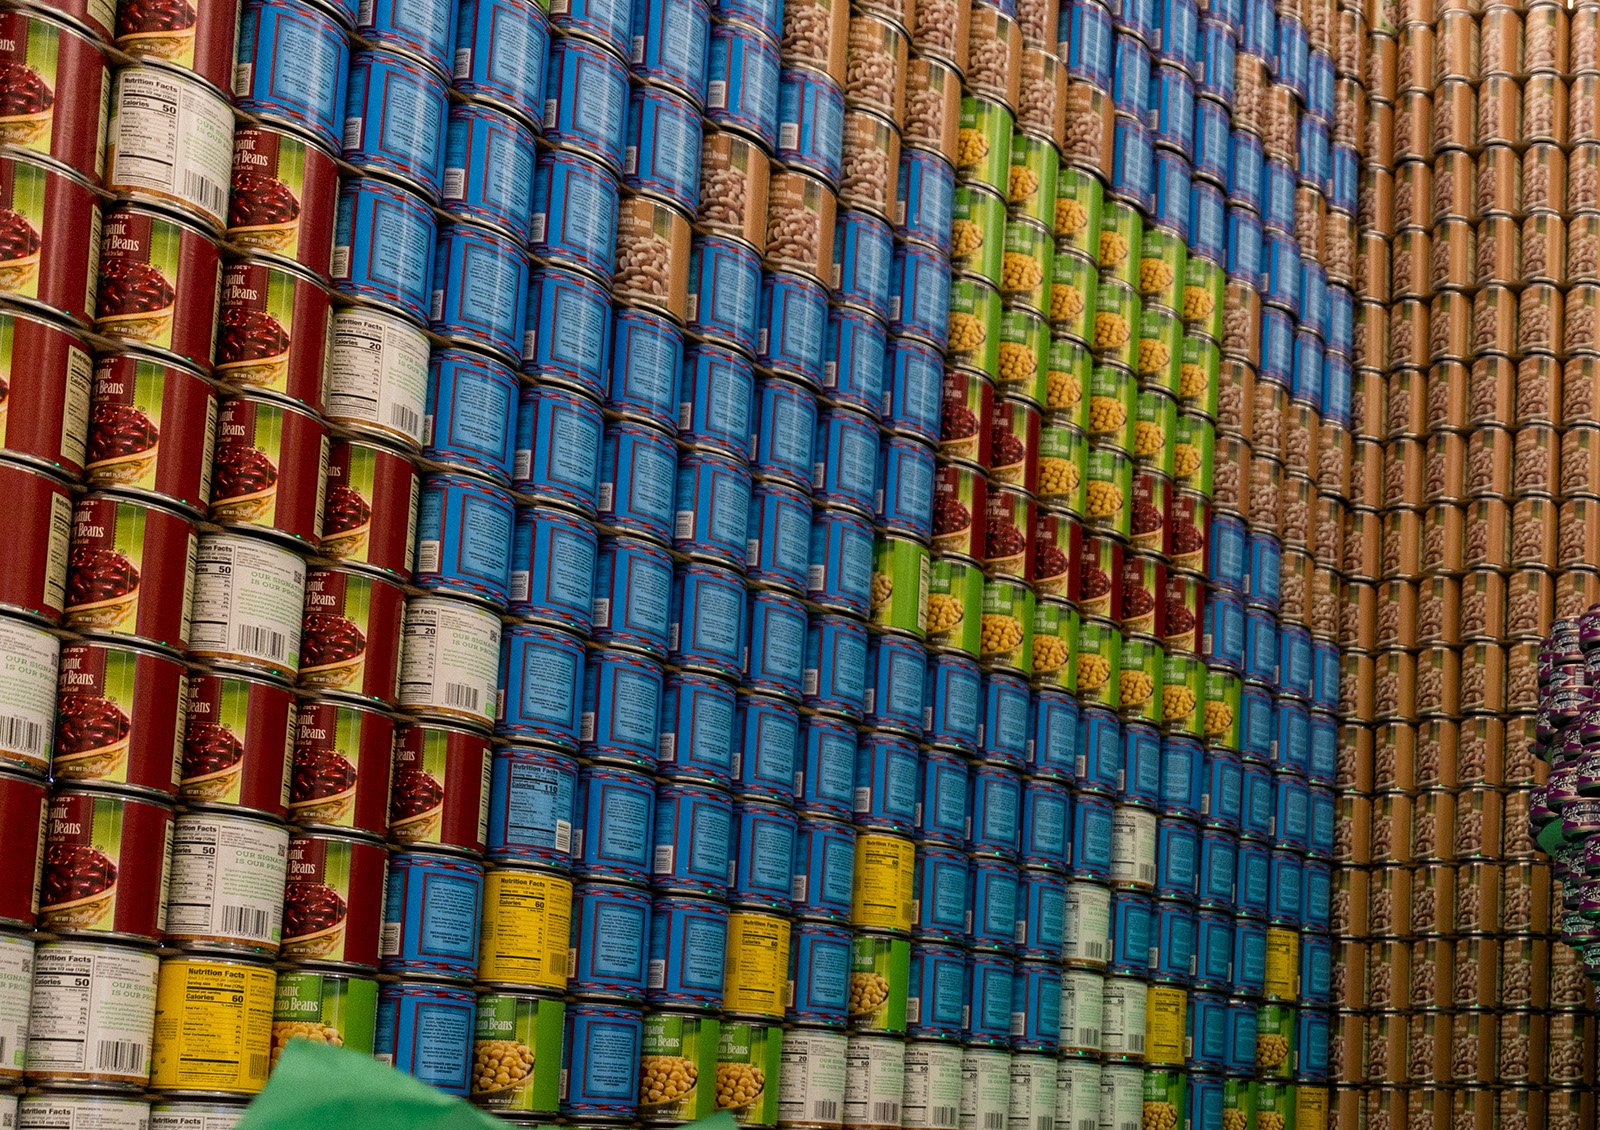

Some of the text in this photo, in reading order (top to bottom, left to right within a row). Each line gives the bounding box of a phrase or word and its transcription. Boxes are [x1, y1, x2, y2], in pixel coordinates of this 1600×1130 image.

[124, 77, 178, 93] Nutrition Facts
[123, 100, 177, 115] Calories 50
[241, 149, 269, 167] Beans
[111, 234, 140, 251] Beans
[231, 285, 258, 300] Beans
[336, 318, 383, 331] Nutrition Facts
[369, 342, 381, 351] 20
[99, 379, 124, 394] Beans
[214, 545, 232, 553] Facts
[219, 566, 231, 574] 50
[311, 591, 336, 606] Beans
[425, 627, 436, 635] 20
[68, 672, 94, 686] Beans
[54, 821, 81, 835] Beans
[198, 825, 217, 833] Facts
[202, 846, 215, 855] 50
[291, 860, 316, 874] Beans
[501, 878, 545, 888] Nutrition Facts
[767, 921, 779, 929] Facts
[68, 955, 91, 963] Facts
[188, 968, 245, 979] Nutrition Facts
[74, 978, 89, 987] 50
[111, 981, 132, 990] OUR
[123, 990, 141, 998] OUR
[186, 993, 244, 1003] Calories 60
[290, 997, 318, 1012] Beans
[489, 1018, 513, 1031] Beans
[657, 1036, 679, 1048] Beans
[725, 1042, 748, 1054] Beans
[21, 1108, 47, 1116] Nutrition
[153, 1117, 178, 1125] Nutrition
